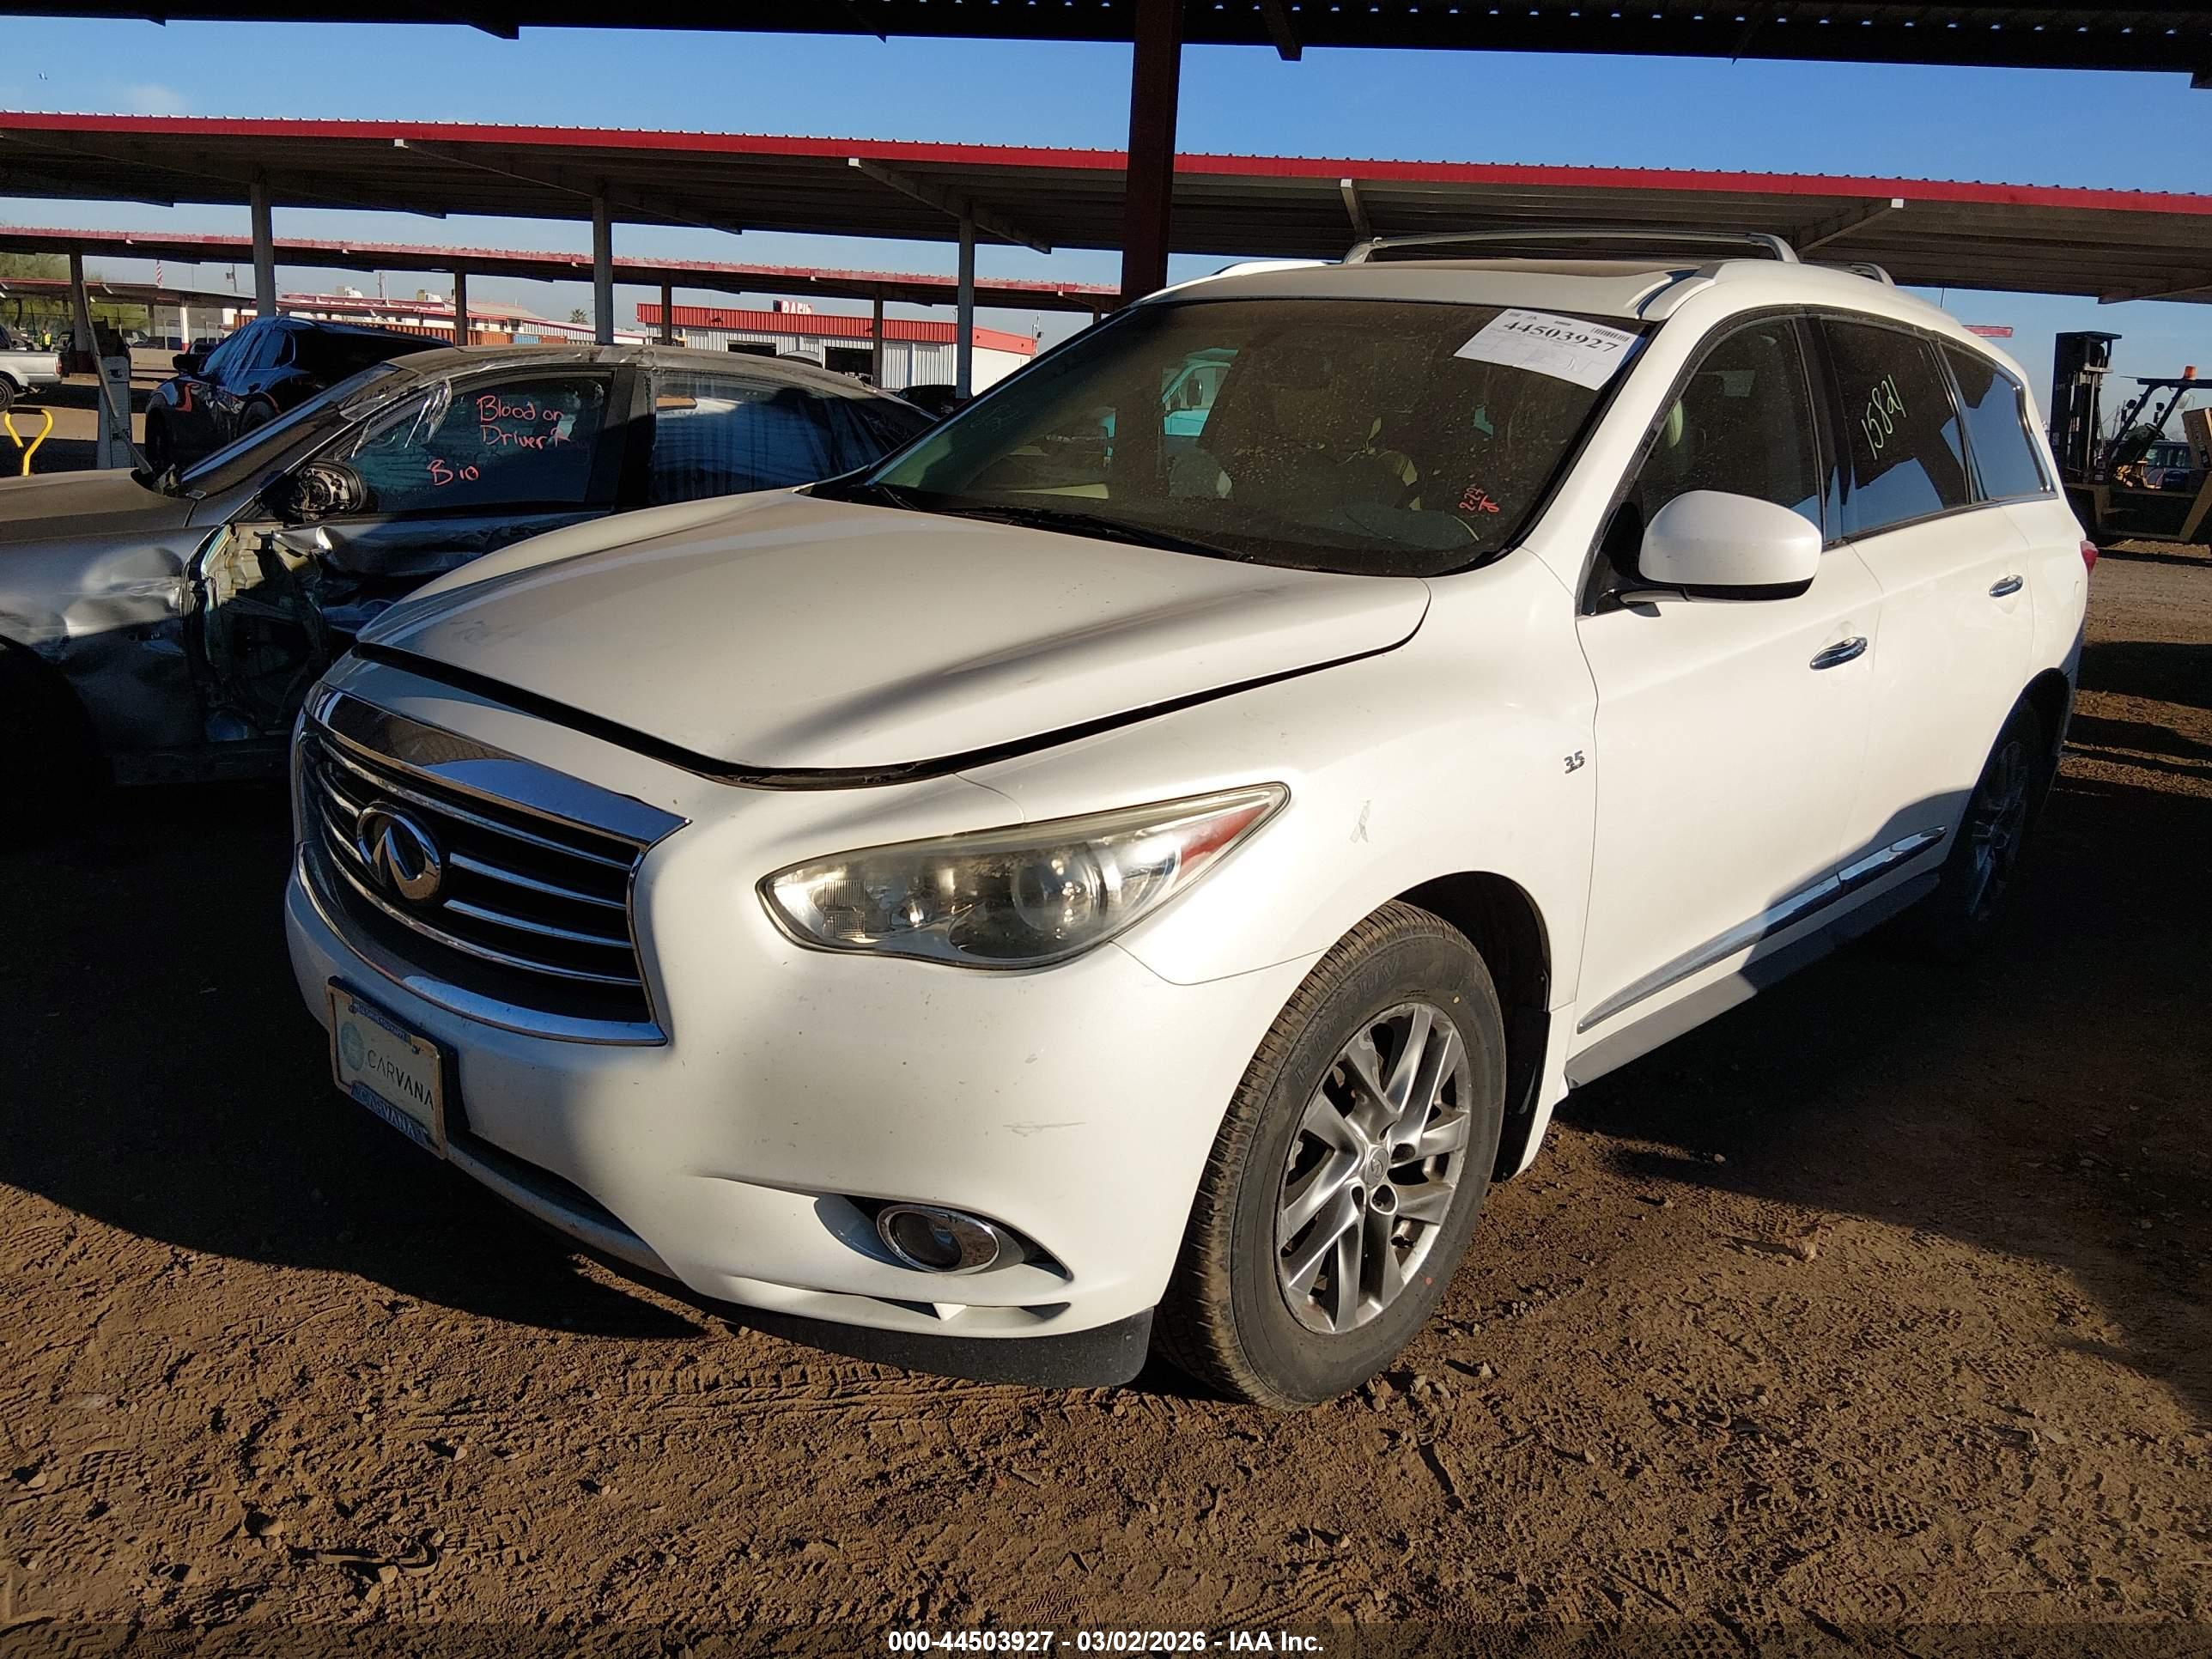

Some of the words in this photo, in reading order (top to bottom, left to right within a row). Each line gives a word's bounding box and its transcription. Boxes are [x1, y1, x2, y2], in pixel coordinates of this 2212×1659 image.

[1504, 320, 1620, 352] 44503927
[477, 395, 535, 422] Blood
[543, 410, 562, 421] on
[1861, 374, 1906, 459] 15821
[480, 425, 547, 449] Driver
[427, 459, 479, 485] Bio
[368, 1049, 434, 1111] CARVANA
